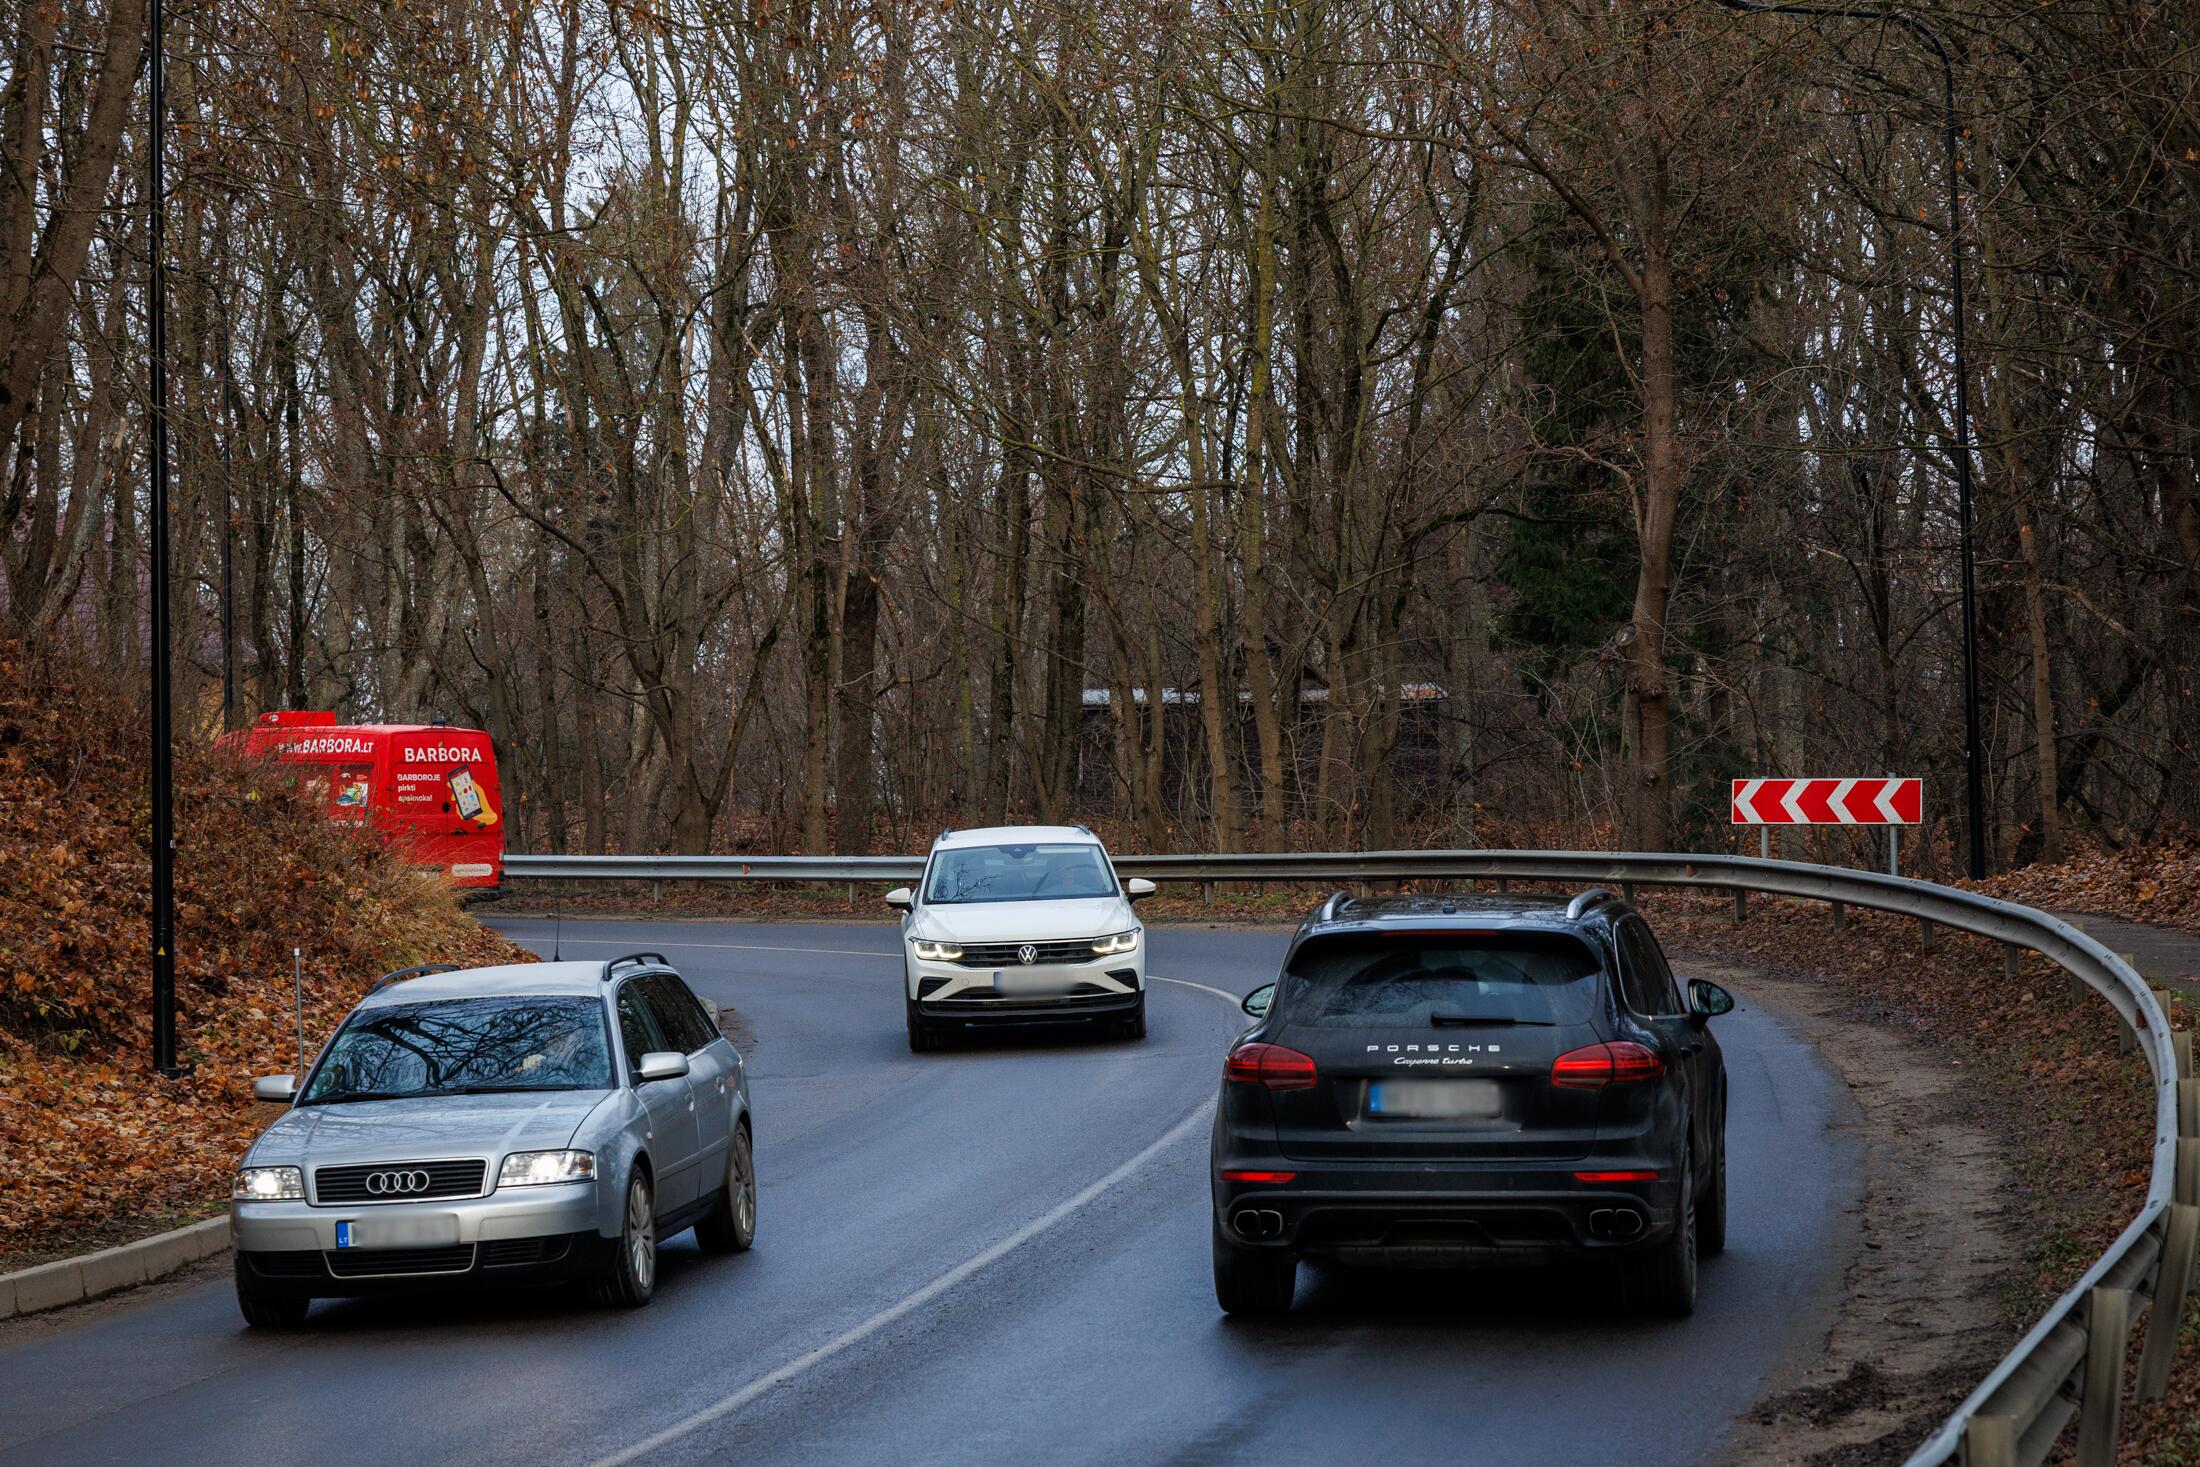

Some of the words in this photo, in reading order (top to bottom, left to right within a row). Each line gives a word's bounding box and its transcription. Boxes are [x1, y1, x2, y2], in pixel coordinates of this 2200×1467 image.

[404, 747, 482, 762] BARBORA
[397, 773, 441, 781] BARBOROJE
[397, 783, 416, 792] pirkti
[1394, 1056, 1439, 1067] Cayenne
[1442, 1056, 1473, 1065] turbo
